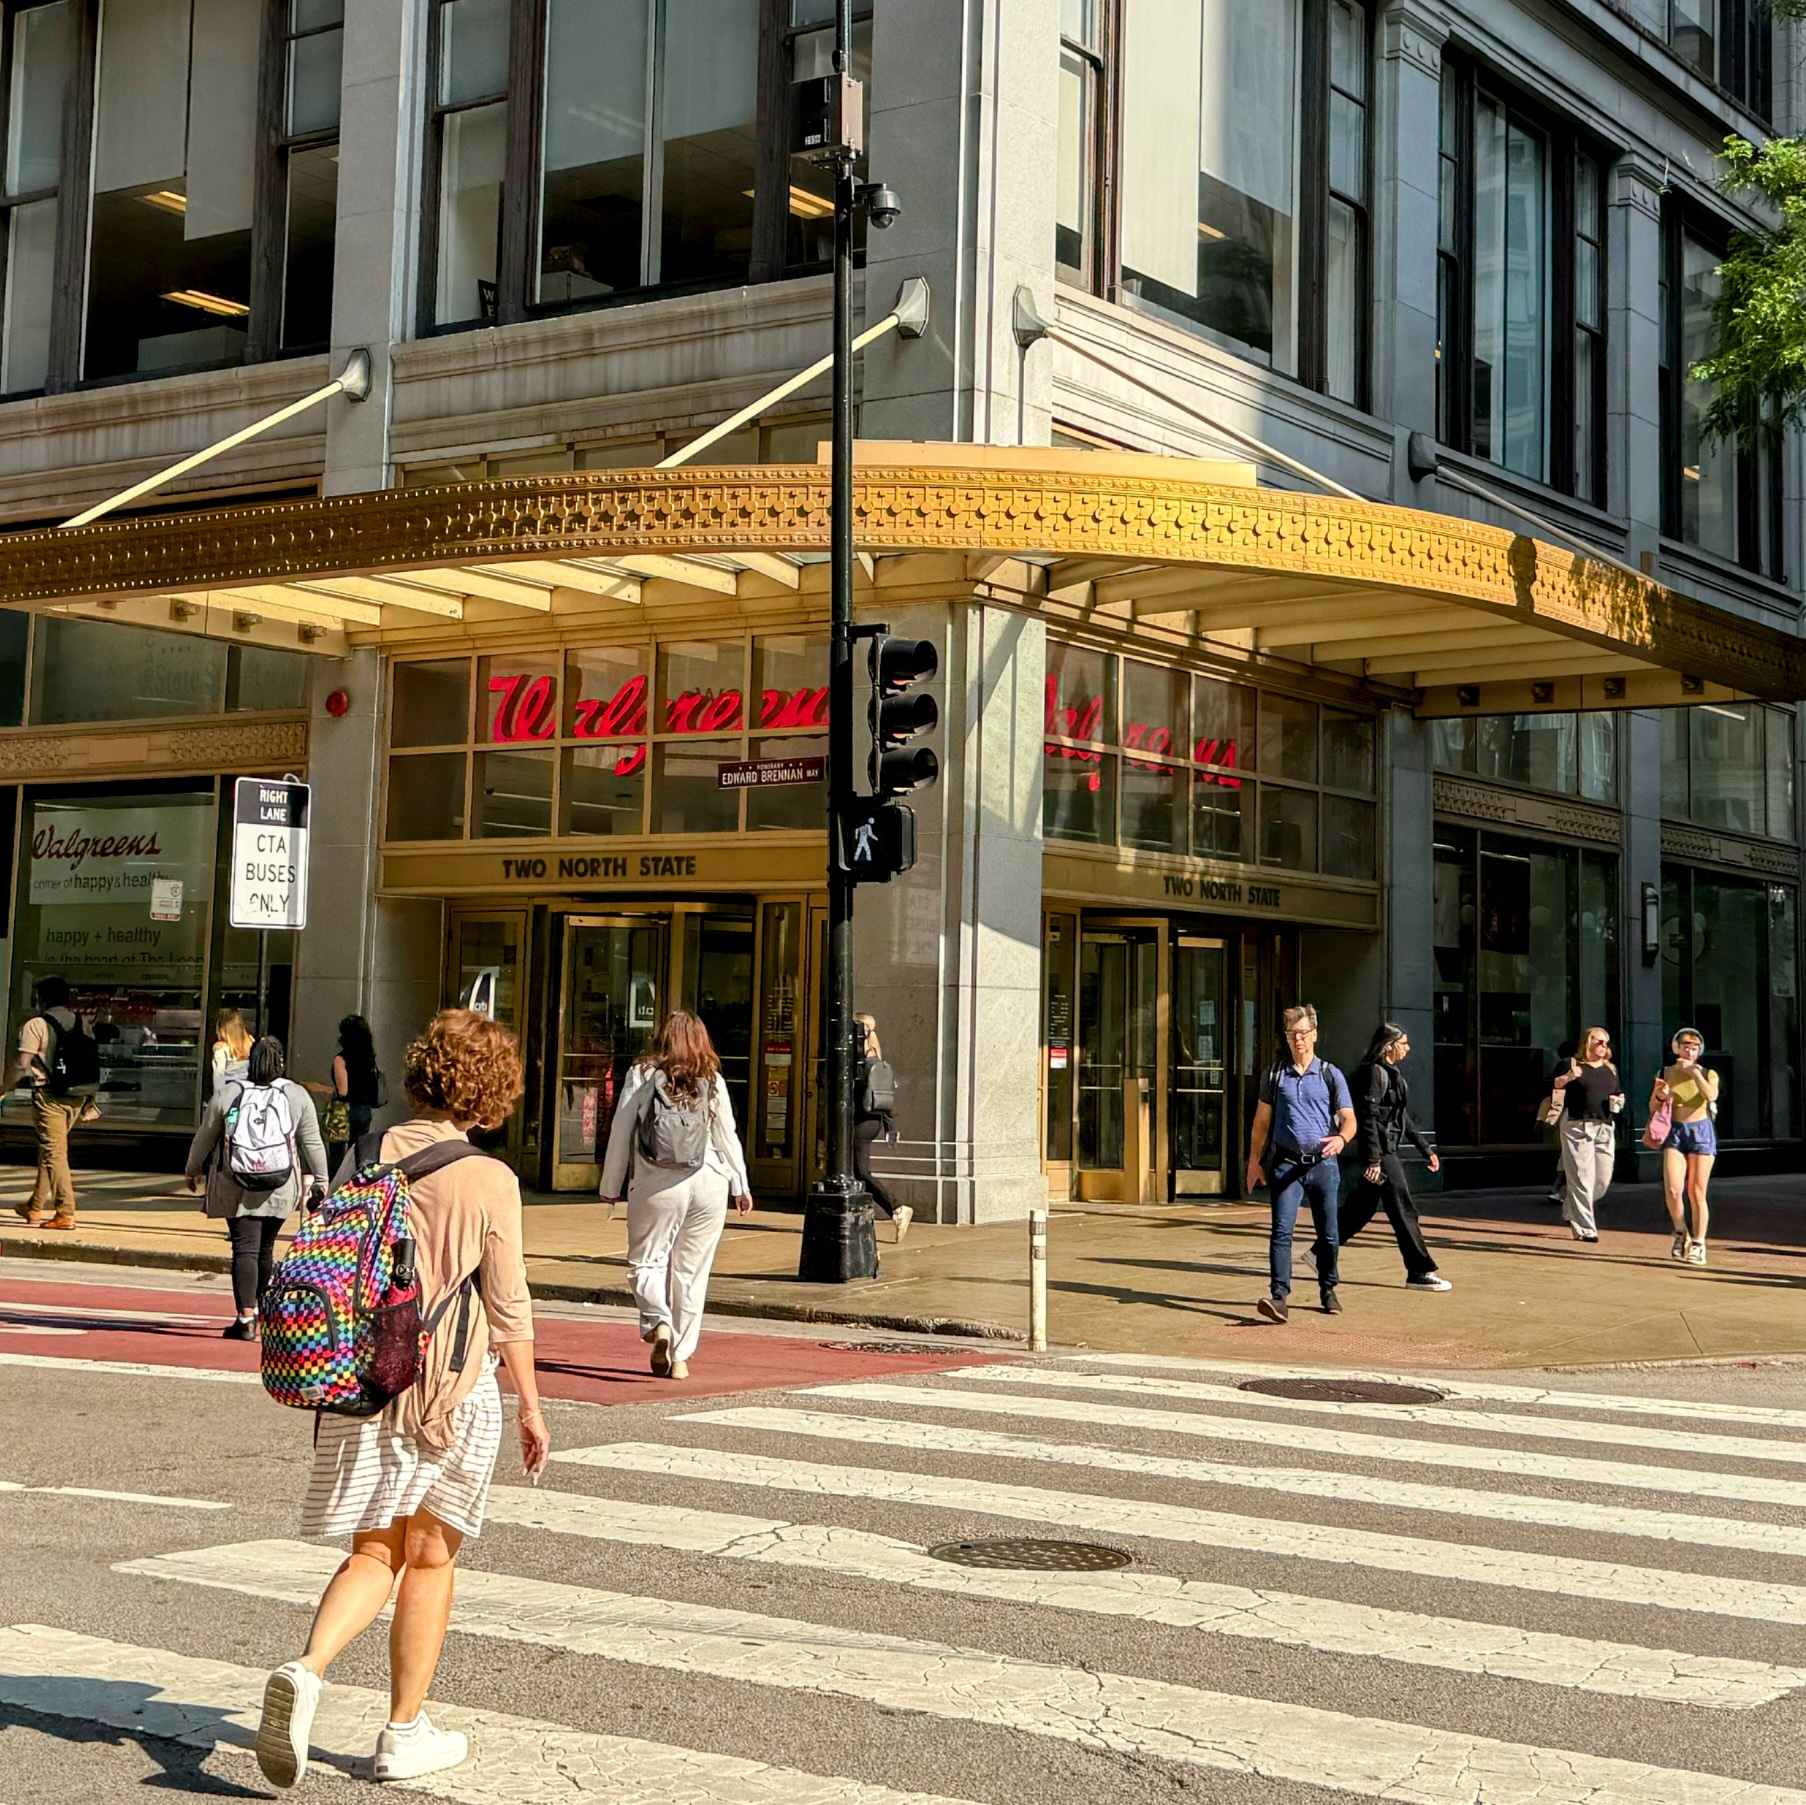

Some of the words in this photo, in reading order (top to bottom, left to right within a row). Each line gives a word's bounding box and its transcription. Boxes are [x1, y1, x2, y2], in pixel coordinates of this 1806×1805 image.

[488, 674, 830, 777] Walgreen
[722, 771, 758, 785] EDWARD
[761, 768, 803, 783] BRENNAN
[259, 788, 289, 804] RIGHT
[260, 807, 287, 822] LANE
[257, 834, 287, 853] CTA
[245, 862, 296, 884] BUSES
[503, 858, 547, 878] TWO
[559, 857, 628, 878] NORTH
[640, 855, 697, 877] STATE
[74, 873, 114, 892] happy
[1163, 875, 1193, 897] TWO
[1200, 879, 1242, 903] NORTH
[1248, 886, 1281, 908] STATE
[46, 927, 90, 947] happy
[107, 926, 161, 947] healthy
